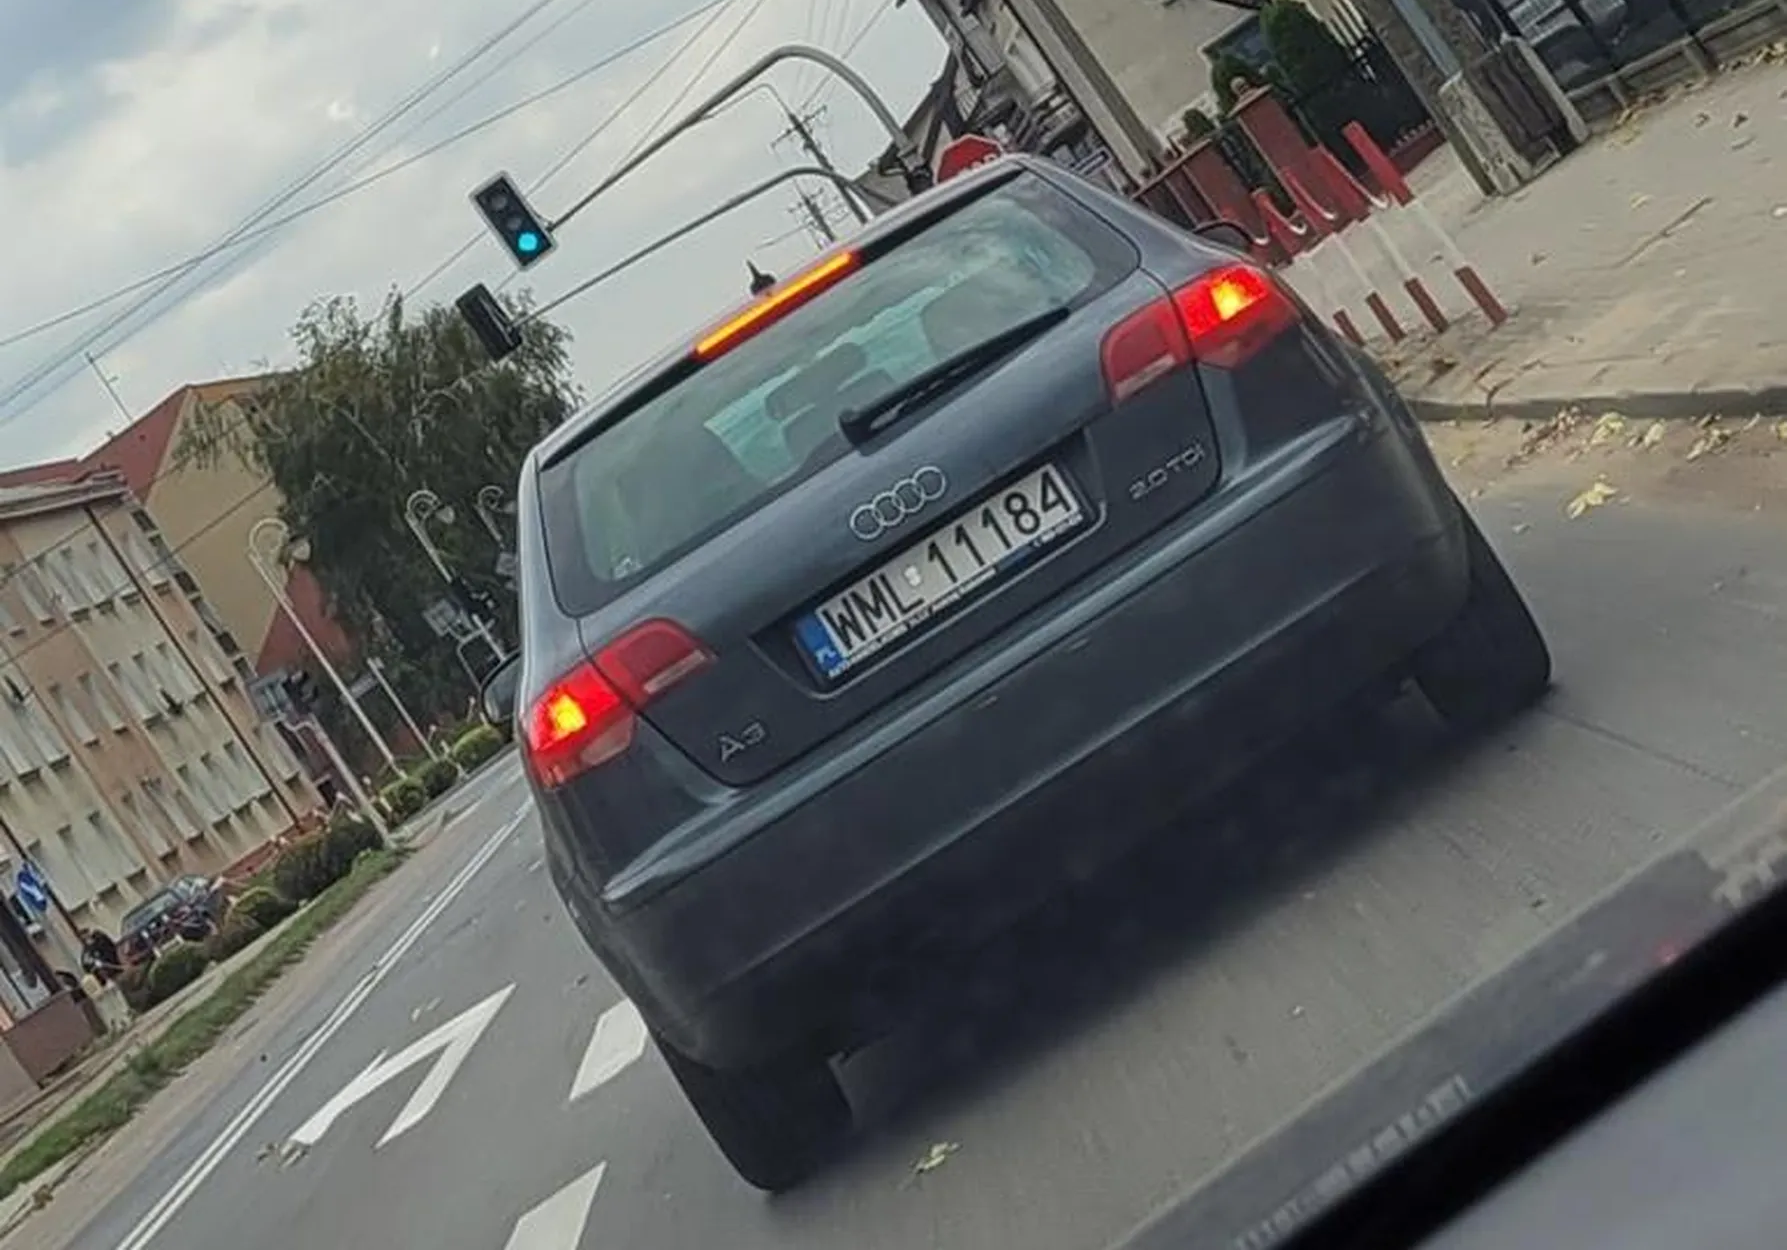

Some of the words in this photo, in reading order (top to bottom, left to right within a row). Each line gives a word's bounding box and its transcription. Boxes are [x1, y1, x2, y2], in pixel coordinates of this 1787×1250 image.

[822, 573, 925, 650] WML
[927, 469, 1072, 584] 11184
[719, 721, 766, 763] A3
